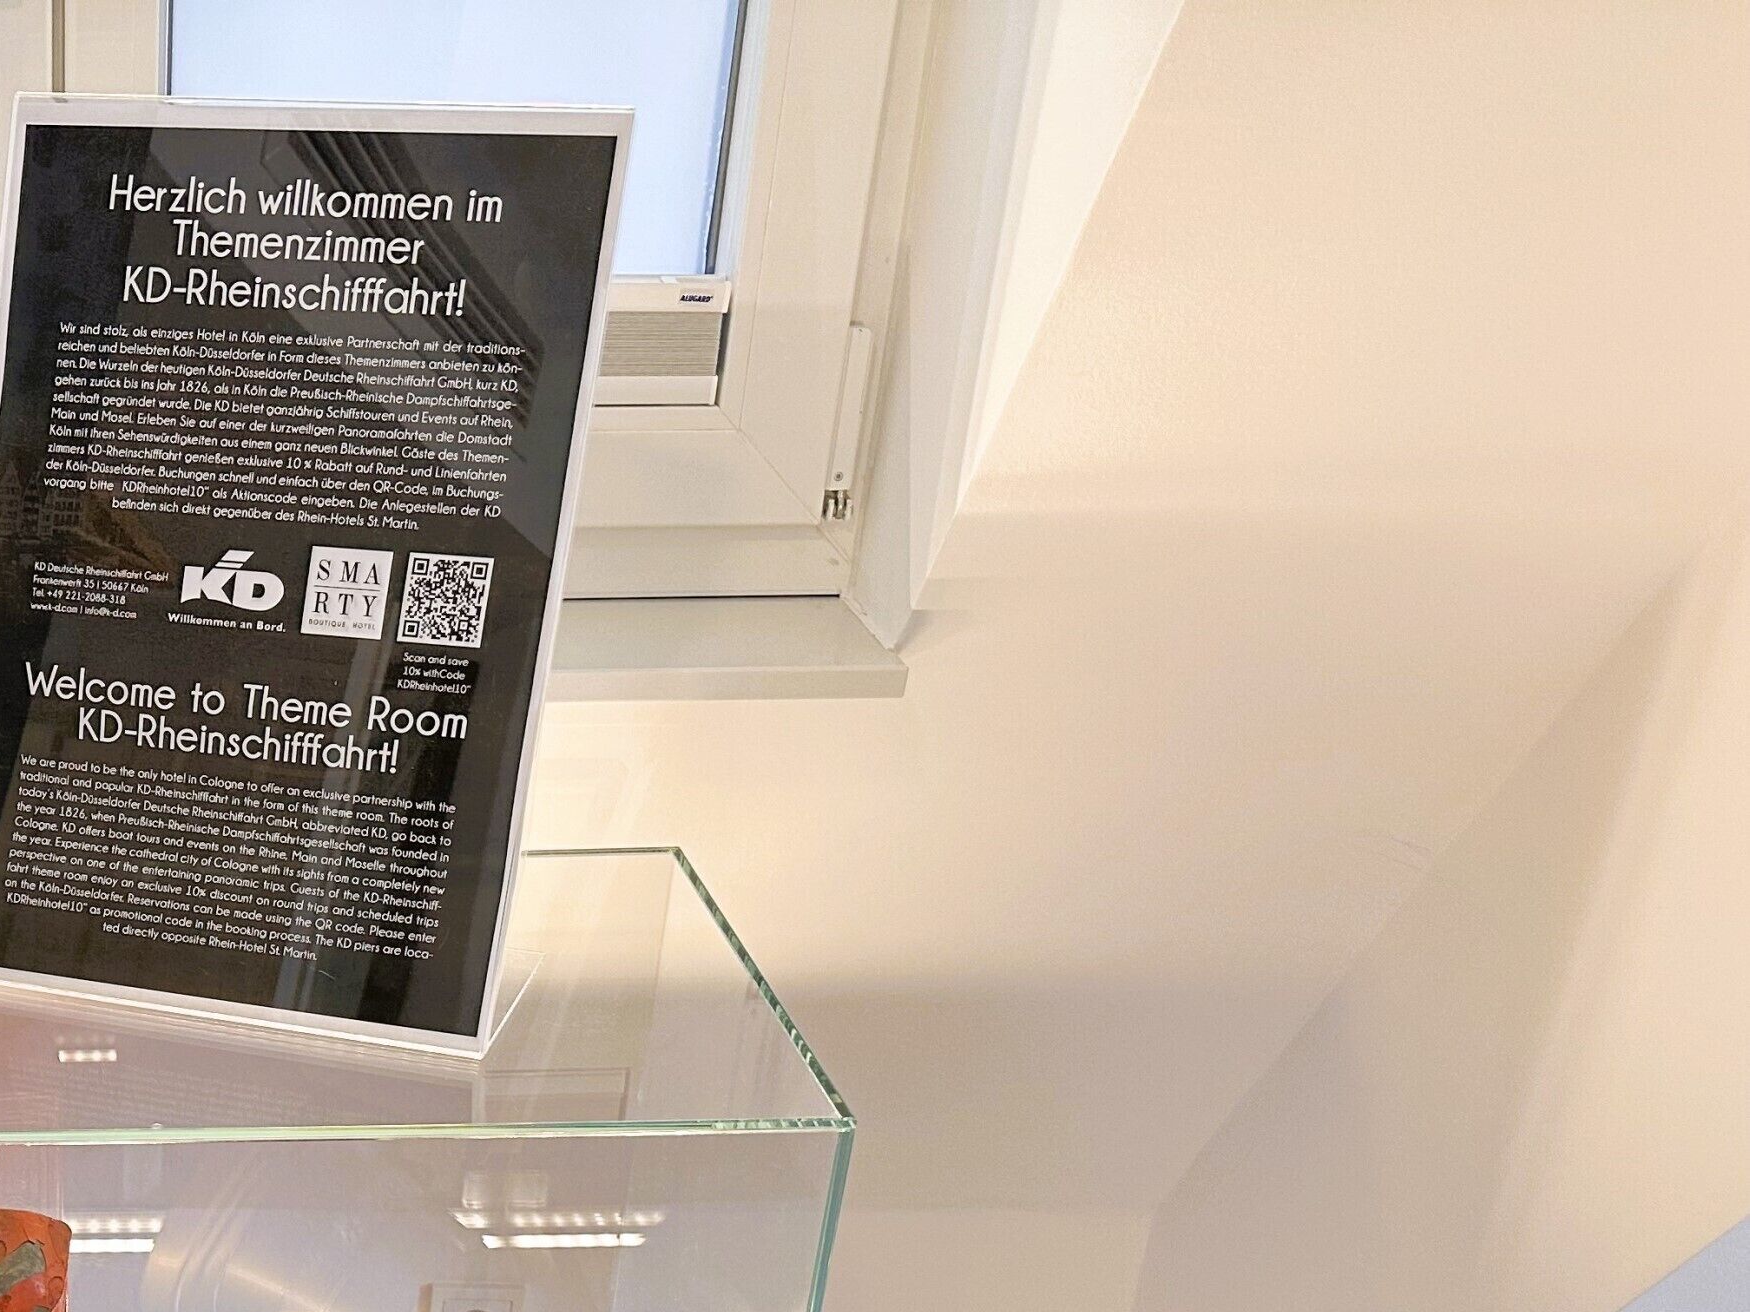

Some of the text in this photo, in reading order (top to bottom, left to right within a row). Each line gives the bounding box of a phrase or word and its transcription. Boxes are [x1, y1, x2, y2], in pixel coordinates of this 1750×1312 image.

[107, 172, 503, 223] Herzlich willkommen im
[172, 217, 426, 265] Themenzimmer
[122, 264, 467, 317] KD-Rheinschifffahrt!
[149, 327, 194, 341] einziges
[195, 327, 226, 342] Hotel
[294, 333, 344, 347] exklusive
[56, 338, 97, 353] reichen
[118, 340, 170, 356] beliebten
[305, 351, 342, 365] dieses
[427, 357, 480, 372] anbieten
[97, 357, 139, 372] Wurzeln
[159, 360, 206, 377] heutigen
[302, 368, 355, 384] Deutsche
[53, 372, 87, 387] gehen
[88, 375, 122, 389] zurück
[51, 389, 100, 404] sellschaft
[100, 394, 157, 408] gegründet
[230, 399, 265, 414] bietet
[264, 403, 324, 420] ganzjährig
[420, 409, 458, 425] Events
[88, 425, 116, 440] ihren
[239, 437, 273, 450] einem
[302, 442, 338, 454] neuen
[400, 445, 436, 460] Gäste
[135, 411, 177, 427] Erleben
[217, 418, 246, 431] einer
[456, 430, 513, 446] Domstadt
[157, 464, 319, 488] Buchungen schnell einfach
[183, 451, 235, 465] genießen
[235, 453, 284, 468] exklusive
[313, 457, 353, 473] Rabatt
[42, 476, 87, 491] vorgang
[229, 487, 298, 504] Aktionscode
[110, 495, 157, 511] befinden
[180, 501, 212, 516] direkt
[212, 505, 273, 520] gegenüber
[33, 560, 47, 572] KD
[45, 561, 85, 575] Deutsche
[45, 587, 64, 599] +49
[100, 579, 130, 593] 50667
[129, 581, 150, 595] Köln
[180, 563, 285, 612] KD
[166, 611, 286, 633] Willkommen an Bord.
[401, 650, 470, 667] Scan and save
[24, 660, 468, 739] Welcome to Theme Room
[77, 705, 400, 774] KD-Rheinschifffahrt!
[18, 769, 70, 786] traditional
[93, 780, 134, 793] popular
[320, 804, 354, 819] theme
[409, 816, 439, 829] roots
[56, 760, 413, 811] proud hotel Cologne offer exclusive partnership
[17, 785, 54, 800] today's
[142, 798, 190, 816] Deutsche
[300, 818, 370, 837] abbreviated
[53, 835, 421, 894] Experience cathedral Cologne sights completely
[77, 823, 448, 879] offers tours events Moselle throughout
[390, 844, 438, 862] founded
[7, 847, 67, 864] perspective
[203, 873, 260, 889] panoramic
[289, 881, 325, 897] Guests
[5, 860, 439, 928] fahrt theme enjoy exclusive discount round trips scheduled trips
[101, 907, 380, 953] promotional booking piers
[120, 923, 268, 954] directly opposite Rhein-Hotel
[264, 913, 292, 927] using
[367, 923, 406, 940] Please
[406, 931, 437, 944] enter
